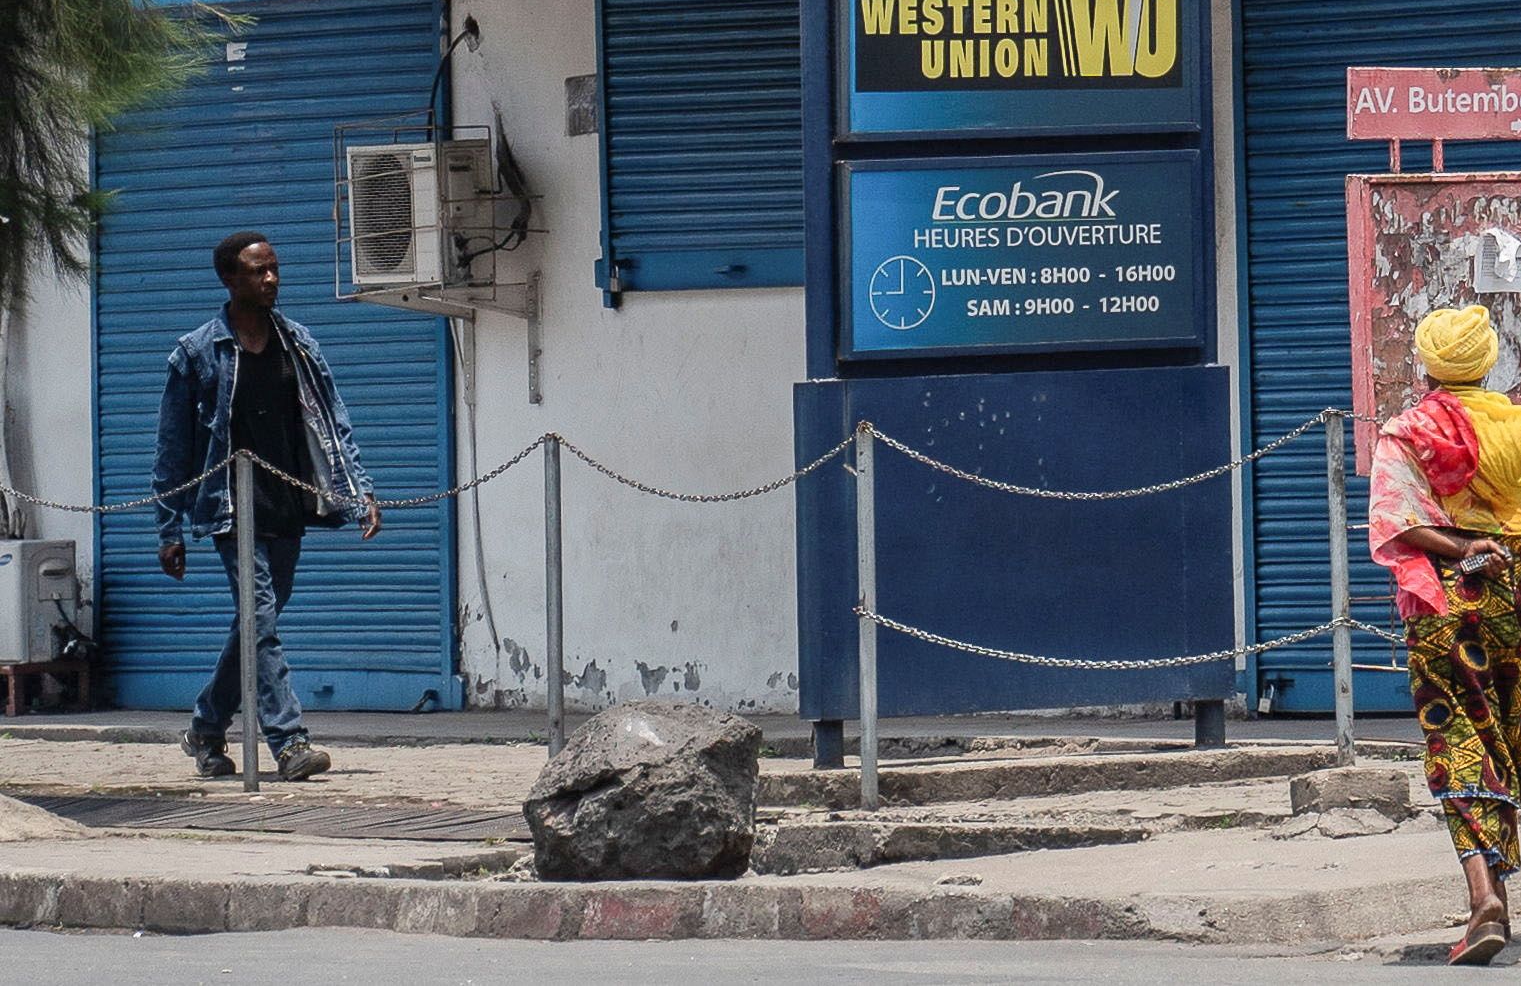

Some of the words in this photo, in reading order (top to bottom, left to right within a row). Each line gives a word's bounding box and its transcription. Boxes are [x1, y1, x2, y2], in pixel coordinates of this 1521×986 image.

[921, 39, 1048, 78] UNION
[1355, 87, 1398, 114] AV.
[932, 170, 1120, 221] Ecobank
[914, 227, 1000, 249] HEURES
[1007, 224, 1161, 247] D'OUVERTURE
[941, 268, 1028, 286] LUN-VEN
[1040, 266, 1091, 284] 8H00
[1115, 265, 1176, 283] 16H00
[967, 299, 1012, 317] SAM
[1024, 298, 1075, 315] 9H00
[1099, 296, 1160, 313] 12H00
